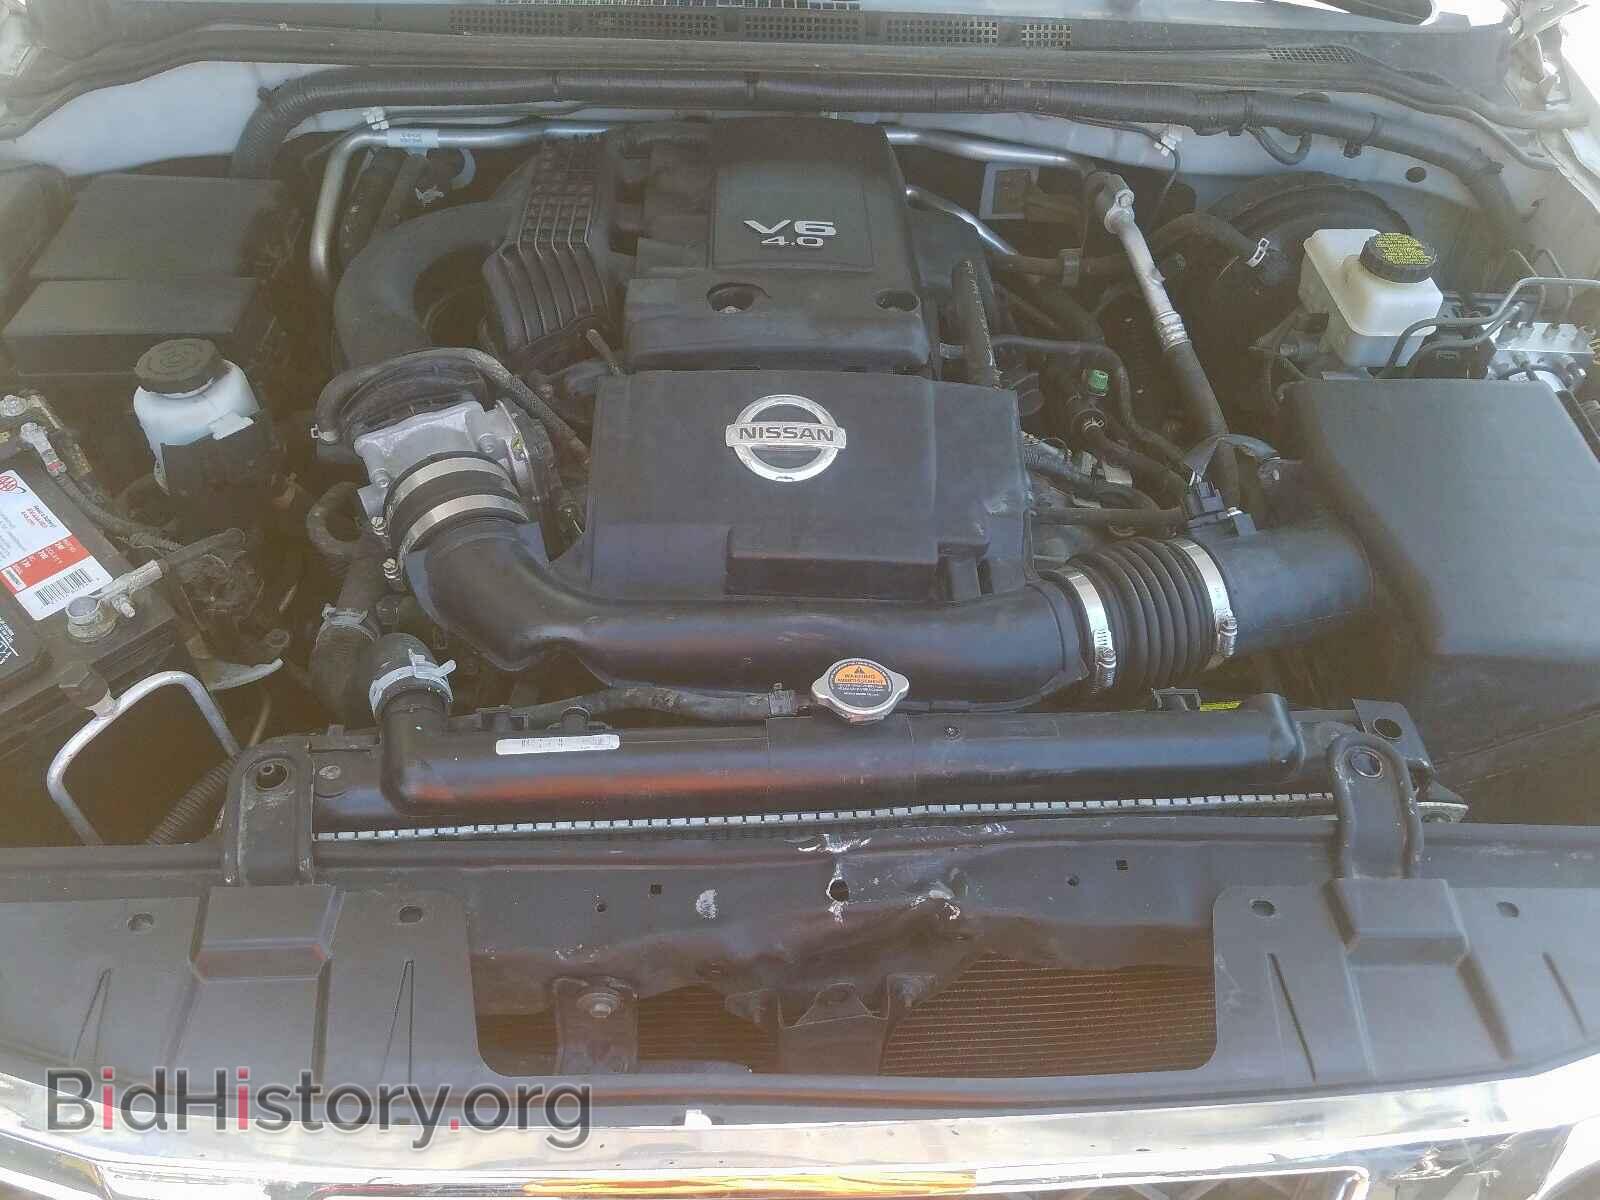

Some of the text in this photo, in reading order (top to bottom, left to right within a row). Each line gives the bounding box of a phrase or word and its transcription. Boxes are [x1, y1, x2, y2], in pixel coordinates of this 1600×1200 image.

[743, 219, 837, 235] V6
[760, 235, 824, 246] 4.0
[739, 426, 834, 442] NISSAN
